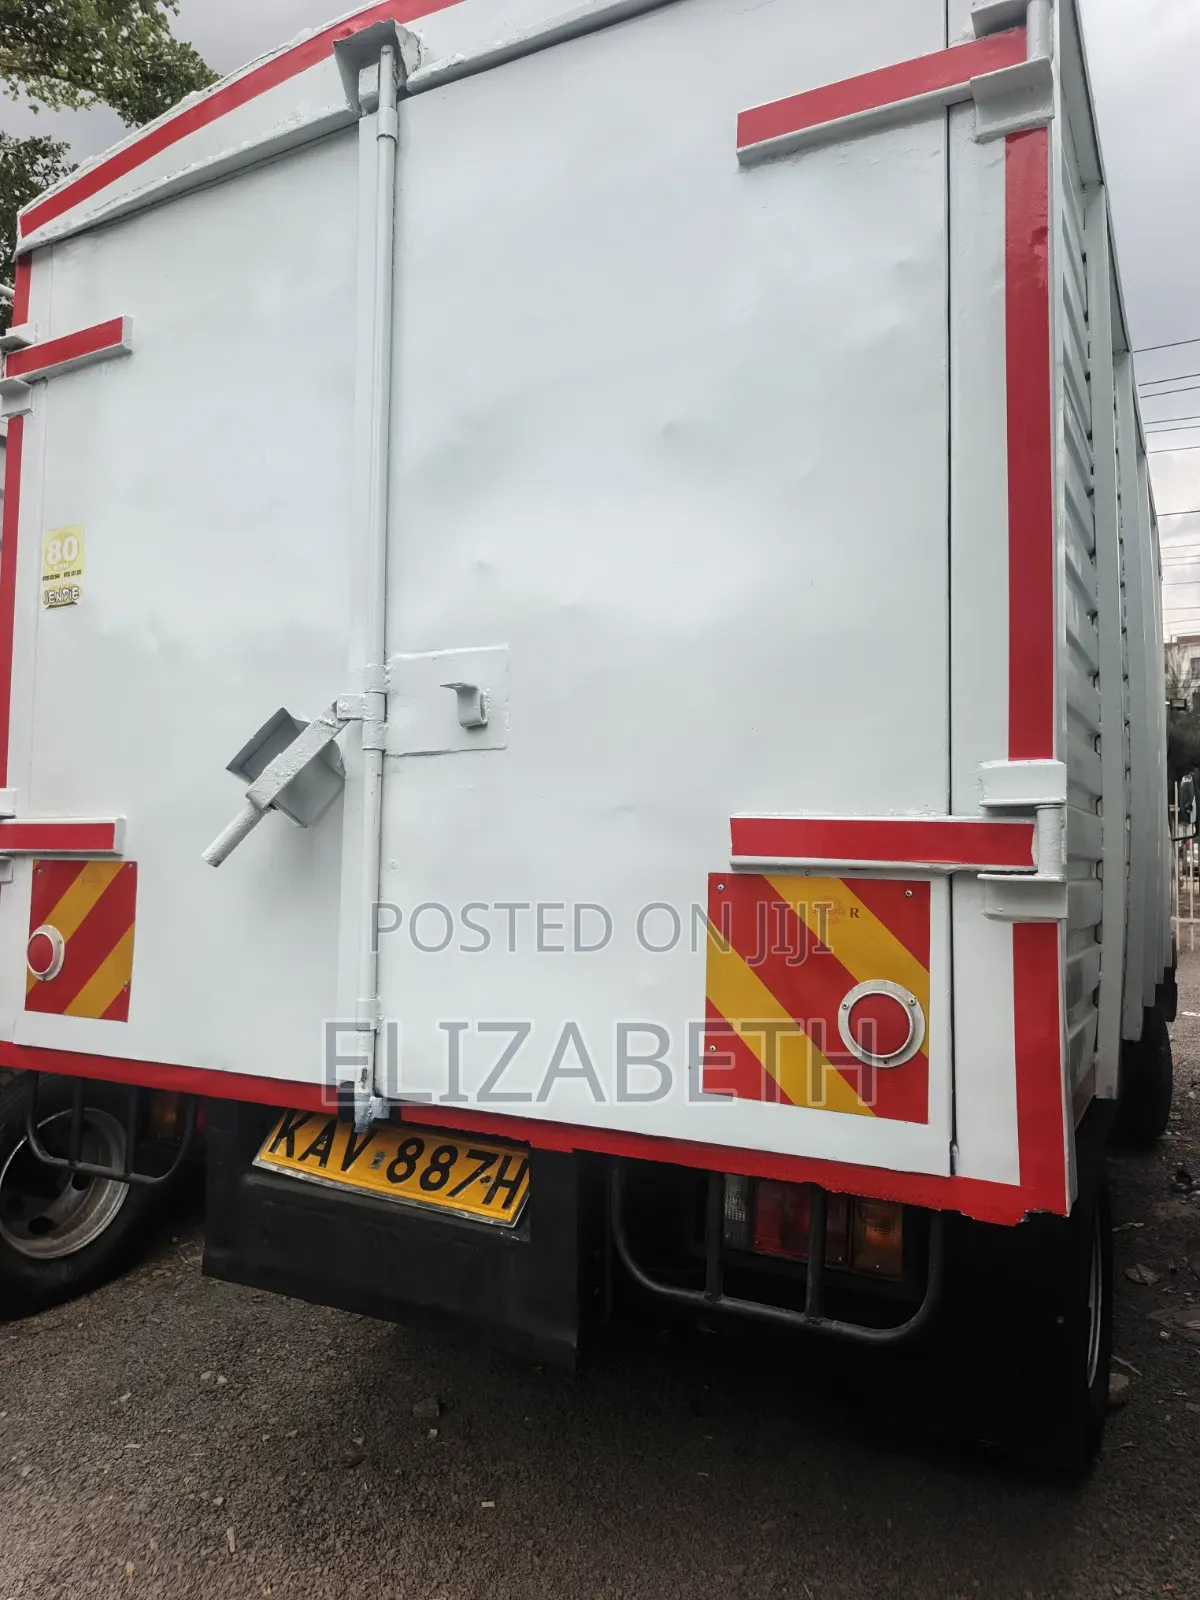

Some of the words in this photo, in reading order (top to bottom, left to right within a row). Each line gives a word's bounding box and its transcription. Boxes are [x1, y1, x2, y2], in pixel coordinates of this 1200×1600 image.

[46, 535, 79, 565] 80
[850, 906, 860, 919] R
[269, 1109, 379, 1172] KAV
[386, 1137, 529, 1210] 887H
